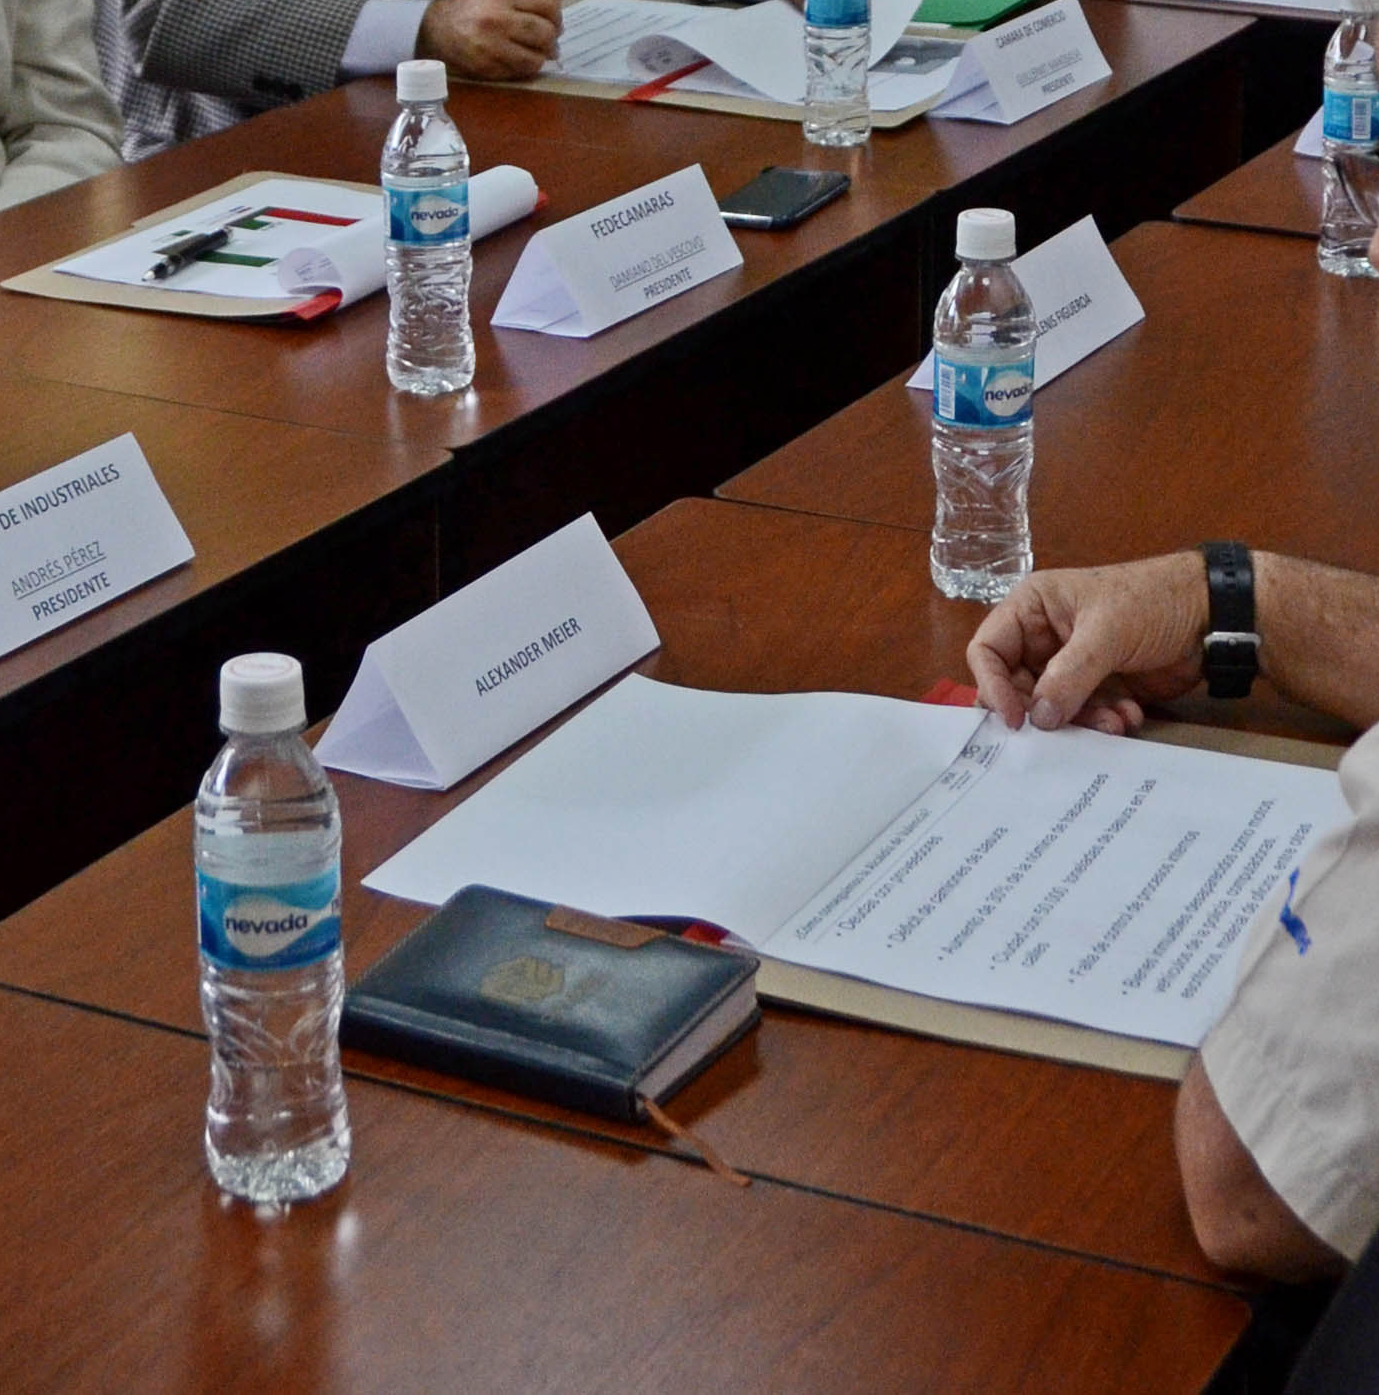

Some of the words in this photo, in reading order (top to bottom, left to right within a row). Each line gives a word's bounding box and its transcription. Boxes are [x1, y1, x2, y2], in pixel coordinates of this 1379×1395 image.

[1023, 23, 1038, 37] DE
[410, 207, 459, 222] nevada
[591, 191, 674, 238] FEDECAMARAS
[644, 268, 692, 299] PRESIDENTE
[1055, 294, 1092, 323] FIGUEROA
[20, 464, 120, 520] INDUSTRIALES
[12, 560, 64, 596] ANDRÉS
[63, 541, 106, 574] PÉREZ
[32, 572, 110, 620] PRESIDENTE
[476, 642, 544, 694] ALEXANDER
[541, 618, 581, 652] MEIER
[225, 912, 308, 935] nevada
